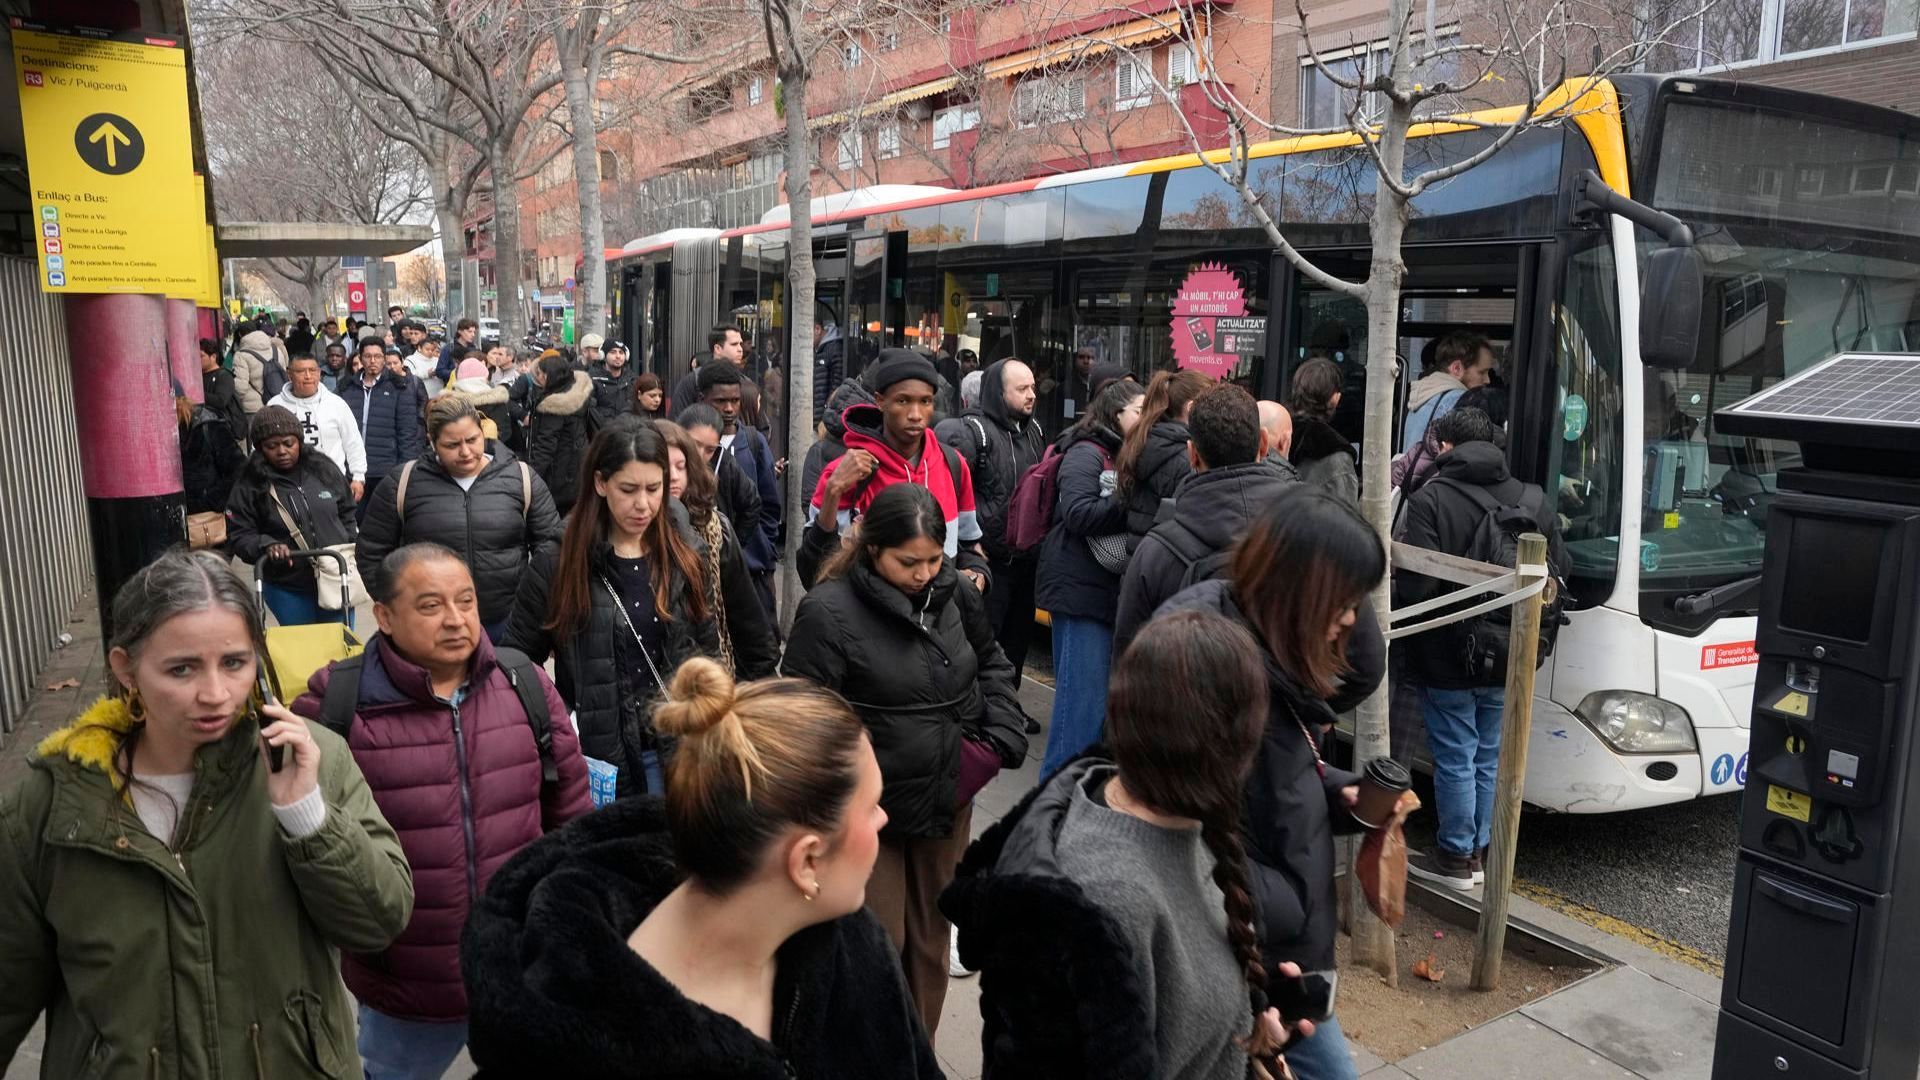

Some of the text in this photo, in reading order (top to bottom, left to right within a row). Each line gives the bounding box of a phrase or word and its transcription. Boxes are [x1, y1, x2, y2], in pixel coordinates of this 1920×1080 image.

[22, 55, 99, 72] Destinacions:
[24, 73, 43, 85] R3
[49, 75, 67, 85] Vic
[76, 79, 128, 92] Puigcerdà
[37, 190, 72, 204] Enllaç
[84, 193, 109, 203] Bus:
[65, 212, 89, 220] Directe
[1181, 289, 1239, 302] AL MÒBIL, T'HI CAP
[1191, 302, 1228, 313] UN AUTOBÚS
[1216, 318, 1266, 329] ACTUALITZA'T
[1189, 354, 1223, 365] moventis.es
[1717, 647, 1746, 657] Generalitat
[1717, 655, 1748, 665] Transports
